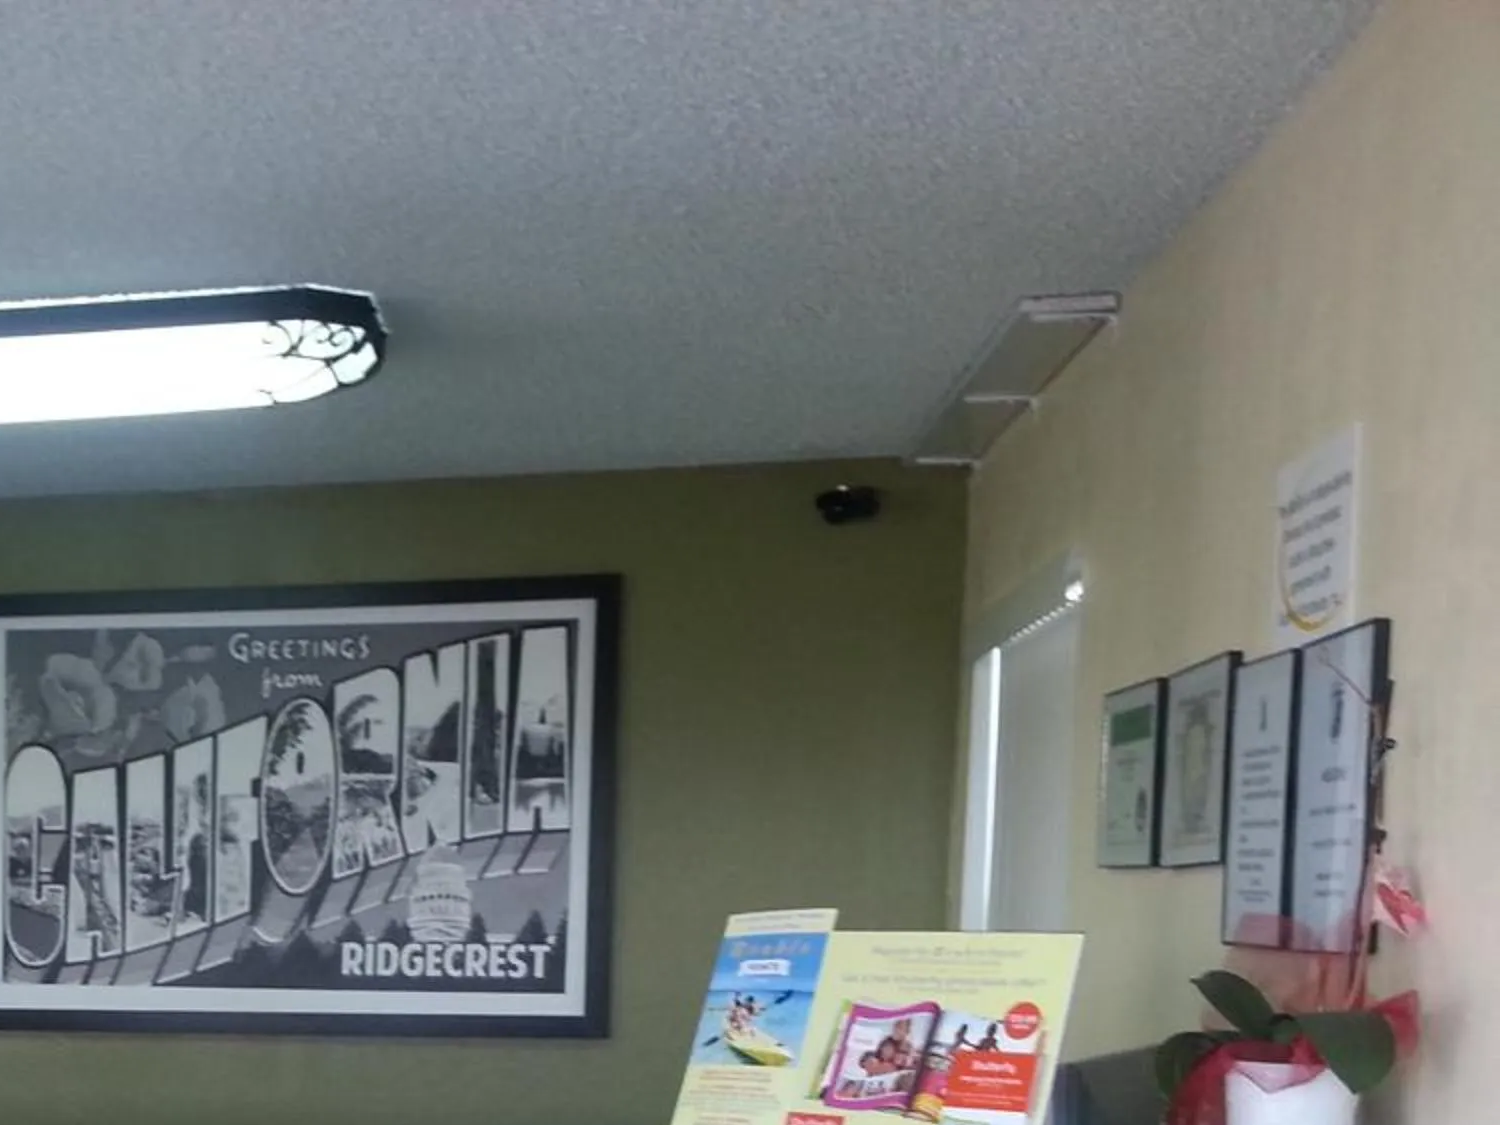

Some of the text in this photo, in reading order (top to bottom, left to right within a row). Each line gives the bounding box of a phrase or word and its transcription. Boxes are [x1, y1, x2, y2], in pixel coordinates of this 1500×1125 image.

[228, 632, 371, 663] GREETINGS
[260, 666, 324, 699] from
[4, 624, 572, 968] CALIFORNIA
[340, 940, 552, 980] RIDGECREST
